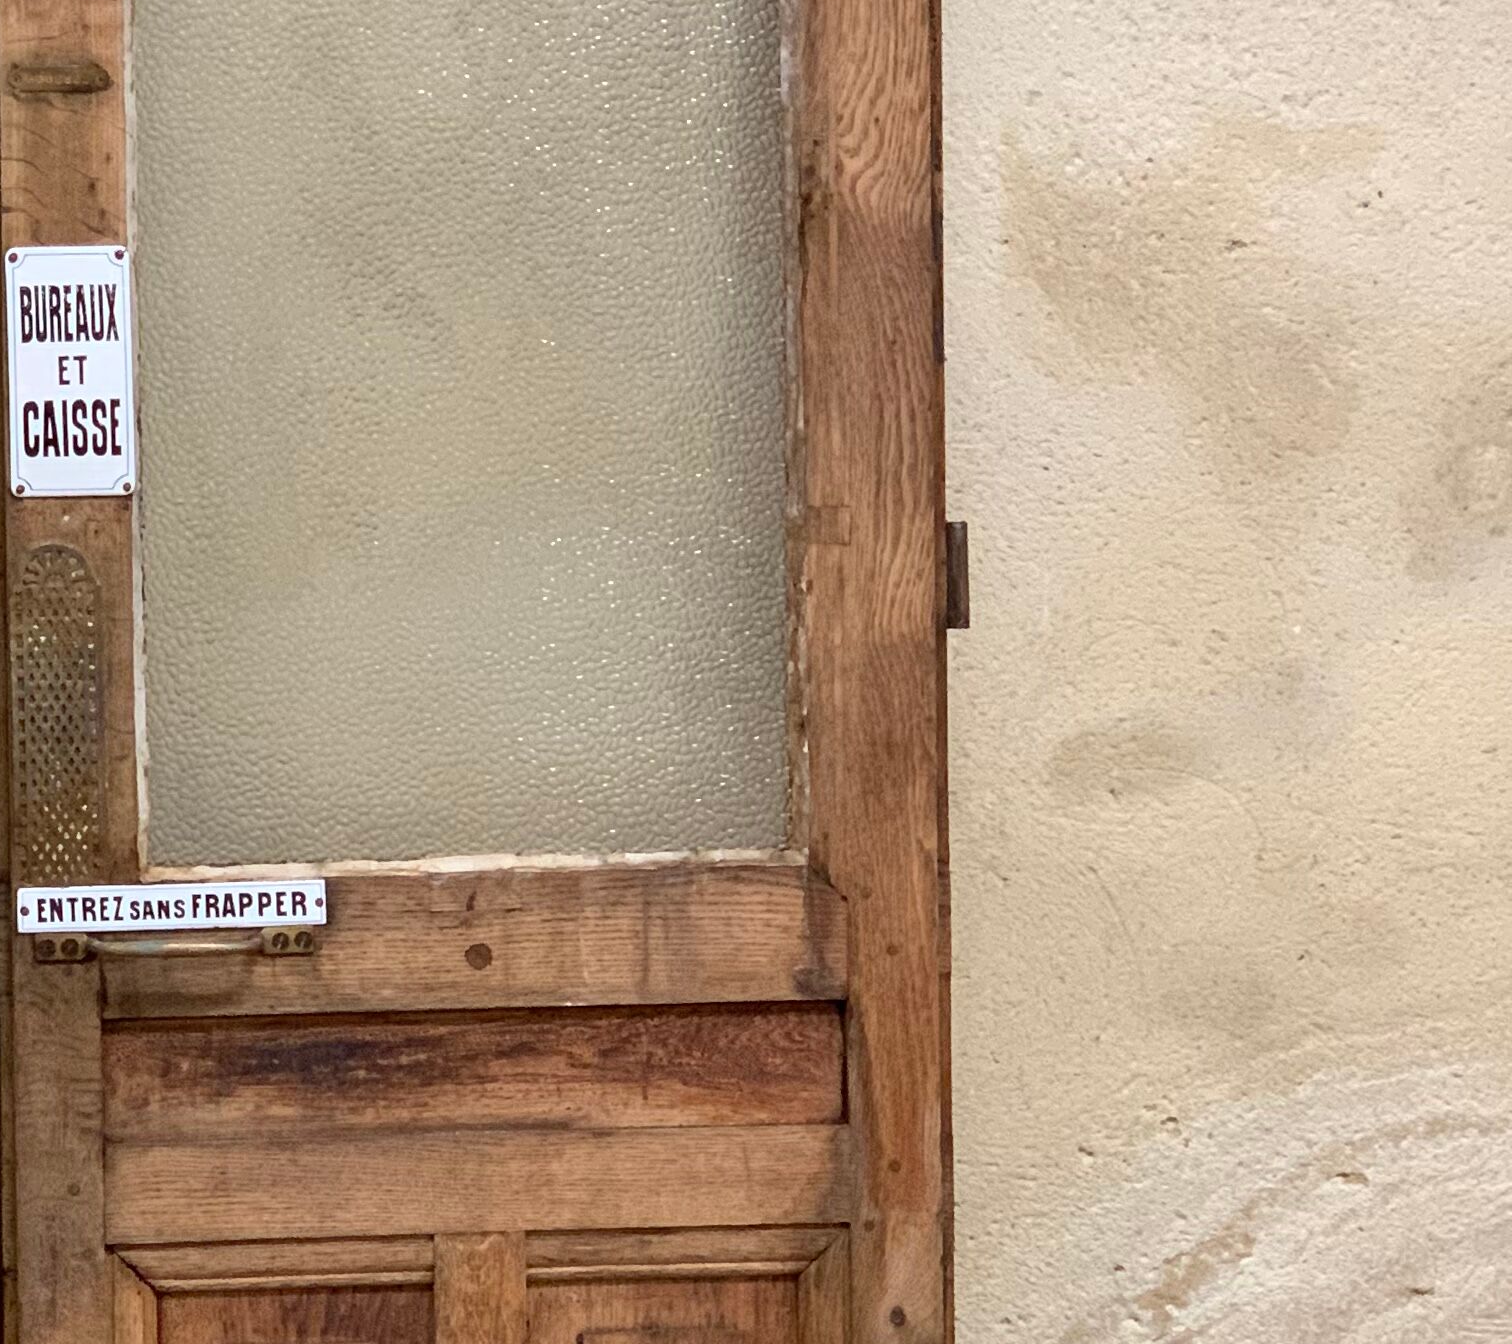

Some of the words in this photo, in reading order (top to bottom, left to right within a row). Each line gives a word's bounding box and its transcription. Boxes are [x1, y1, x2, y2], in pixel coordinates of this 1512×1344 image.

[19, 284, 119, 343] BUREAUX
[58, 356, 88, 385] ET
[23, 399, 122, 457] CAISSE
[37, 896, 124, 923] ENTREZ
[129, 899, 186, 920] SANS
[192, 891, 308, 918] FRAPPER
